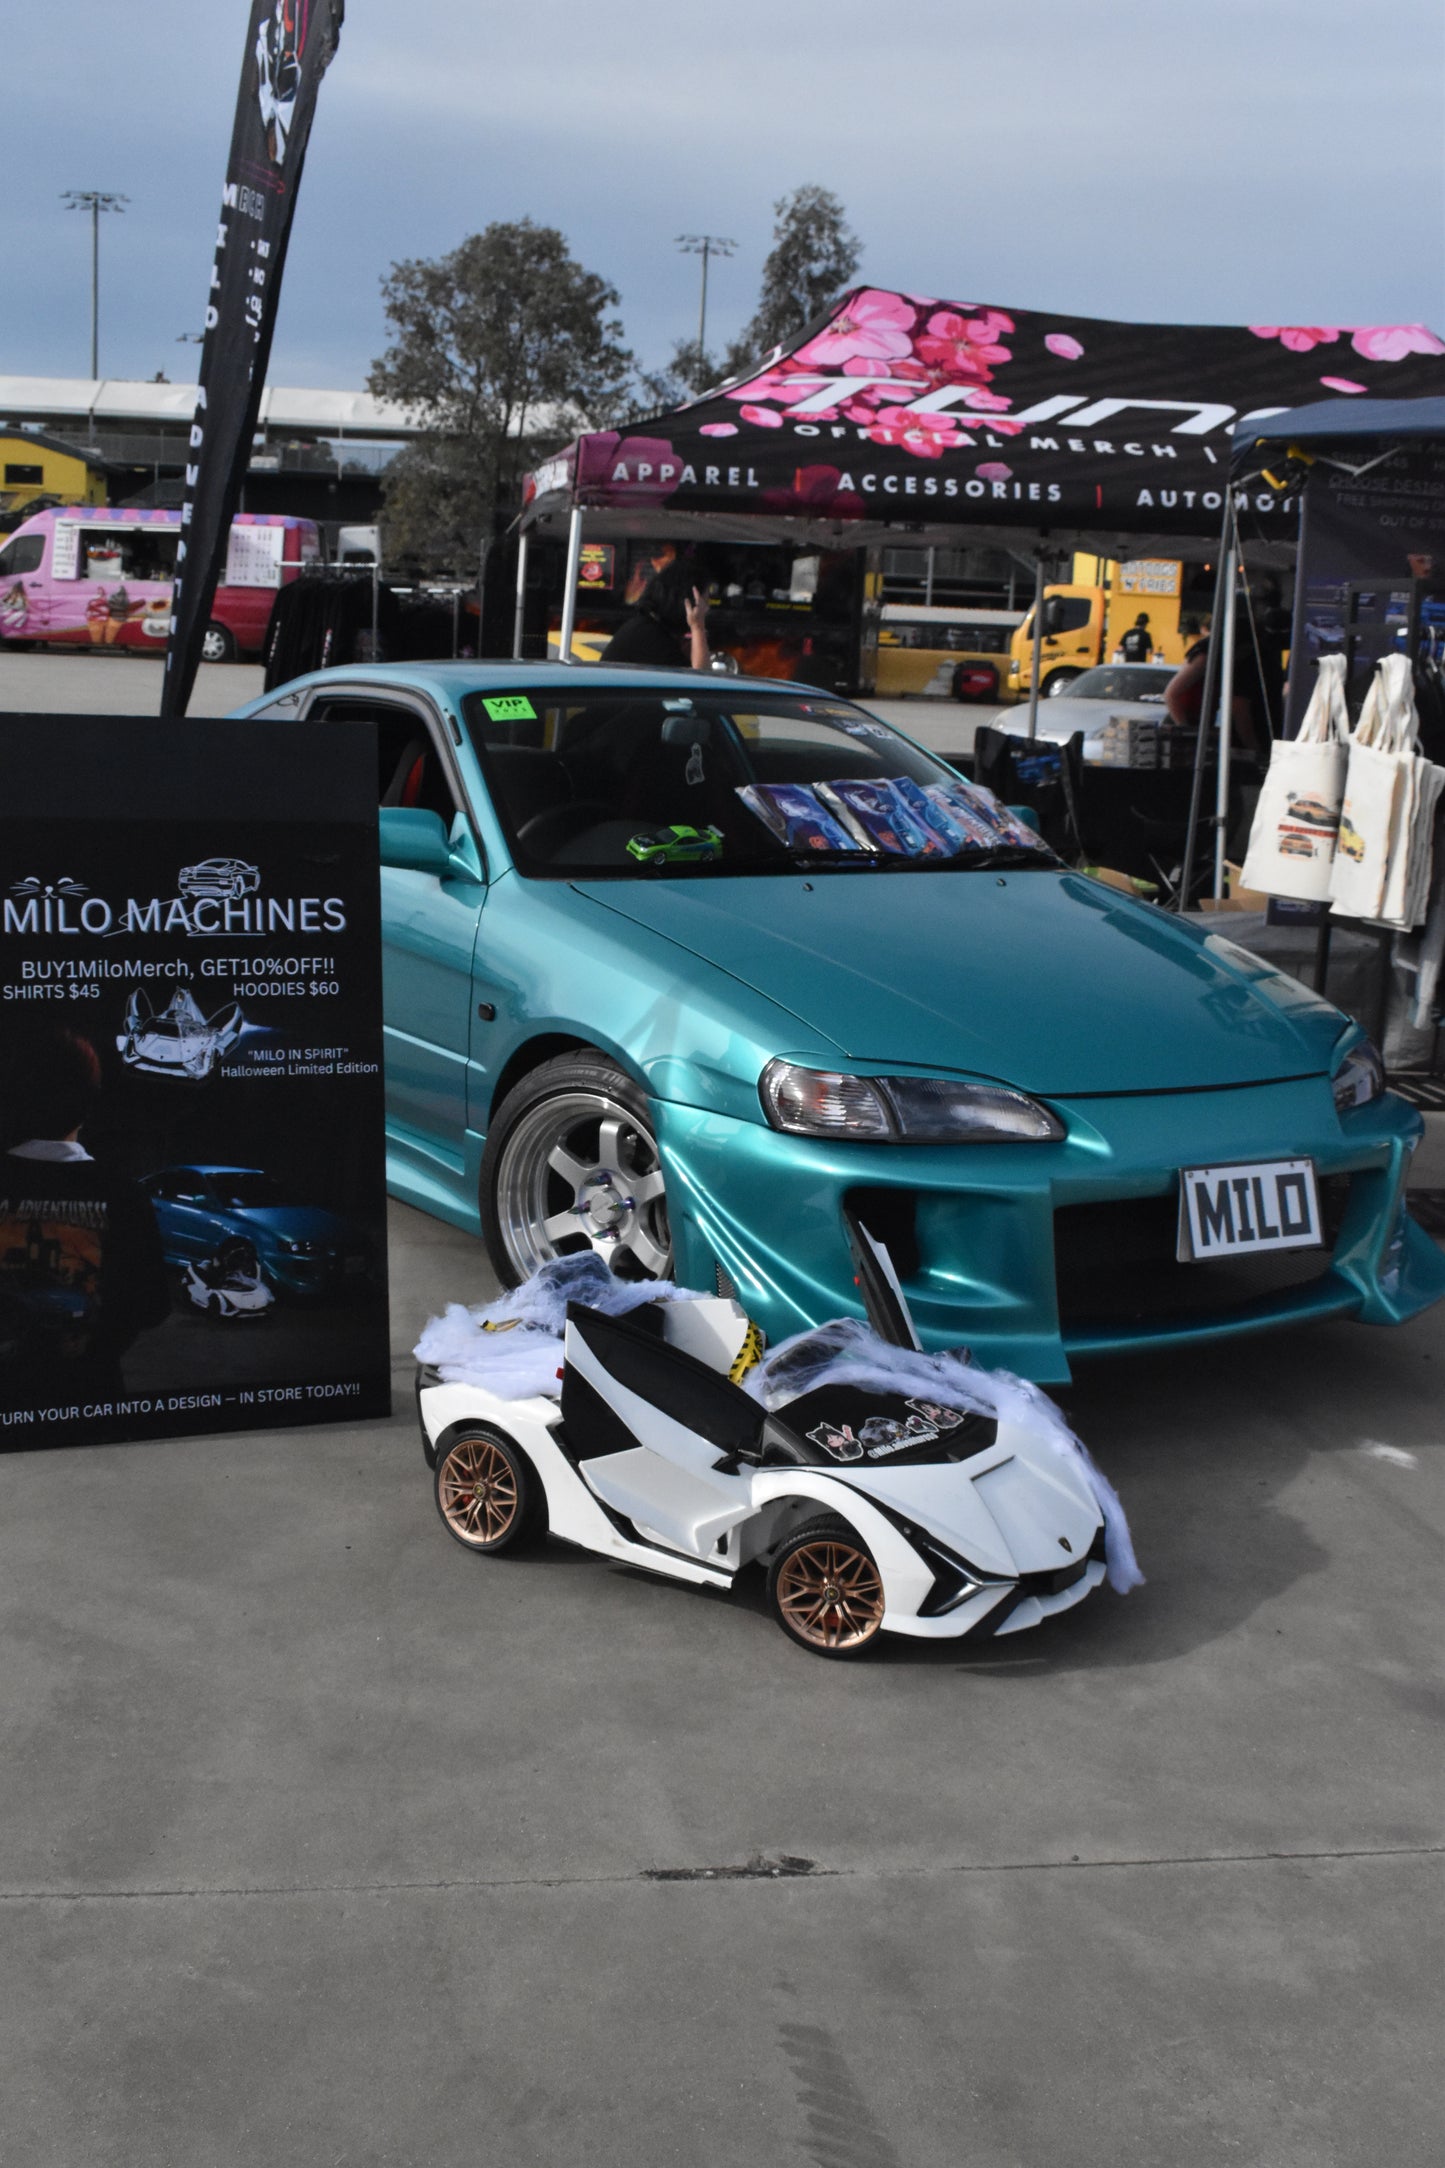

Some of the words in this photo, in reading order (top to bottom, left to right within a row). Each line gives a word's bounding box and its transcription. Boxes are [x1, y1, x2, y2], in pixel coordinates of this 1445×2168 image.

[794, 424, 1004, 448] OFFICIAL
[1030, 436, 1177, 458] MERCH
[612, 462, 759, 488] APPAREL
[838, 472, 1062, 501] ACCESSORIES
[490, 700, 523, 708] VIP
[3, 898, 112, 935] MILO
[126, 897, 347, 934] MACHINES
[200, 957, 336, 977] GET10%OFF!!
[2, 984, 65, 1000] SHIRTS
[69, 982, 100, 999] $45
[233, 982, 306, 997] HOODIES
[309, 980, 340, 997] $60
[247, 1048, 286, 1061] "MILO
[288, 1048, 302, 1060] IN
[304, 1047, 350, 1060] SPIRIT"
[221, 1065, 286, 1078] Halloween
[288, 1063, 334, 1076] Limited
[336, 1061, 379, 1075] Edition
[1195, 1173, 1312, 1247] MILO
[38, 1405, 80, 1423] YOUR
[83, 1402, 114, 1418] CAR
[116, 1400, 151, 1415] INTO
[154, 1398, 165, 1412] A
[169, 1394, 222, 1411] DESIGN
[240, 1391, 255, 1404] IN
[257, 1387, 302, 1403] STORE
[305, 1383, 361, 1400] TODAY!!
